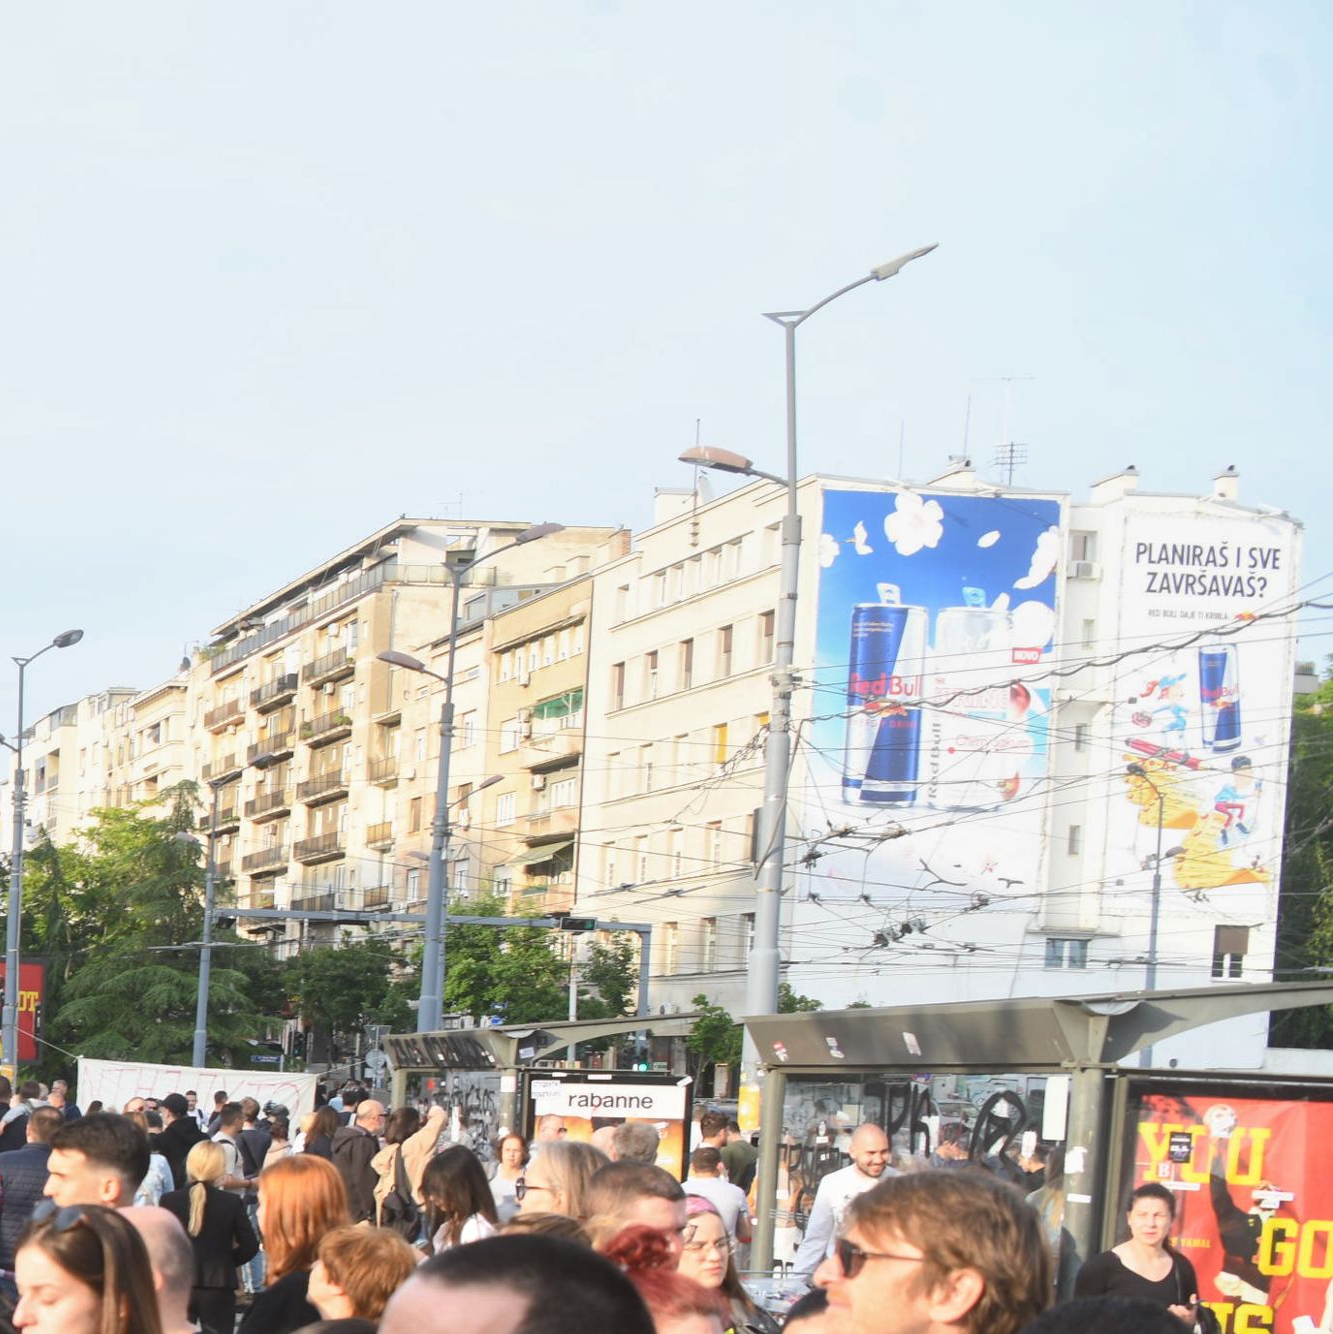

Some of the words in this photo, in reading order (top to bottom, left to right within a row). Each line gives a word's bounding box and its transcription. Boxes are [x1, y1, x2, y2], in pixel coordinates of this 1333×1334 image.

[1136, 541, 1229, 567] PLANIRAŠ
[1236, 547, 1241, 568] I
[1248, 547, 1281, 570] SVE
[1145, 569, 1267, 598] ZAVRŠAVAŠ?
[18, 991, 39, 1012] OT
[568, 1093, 653, 1109] rabanne
[1138, 1122, 1271, 1185] YOU
